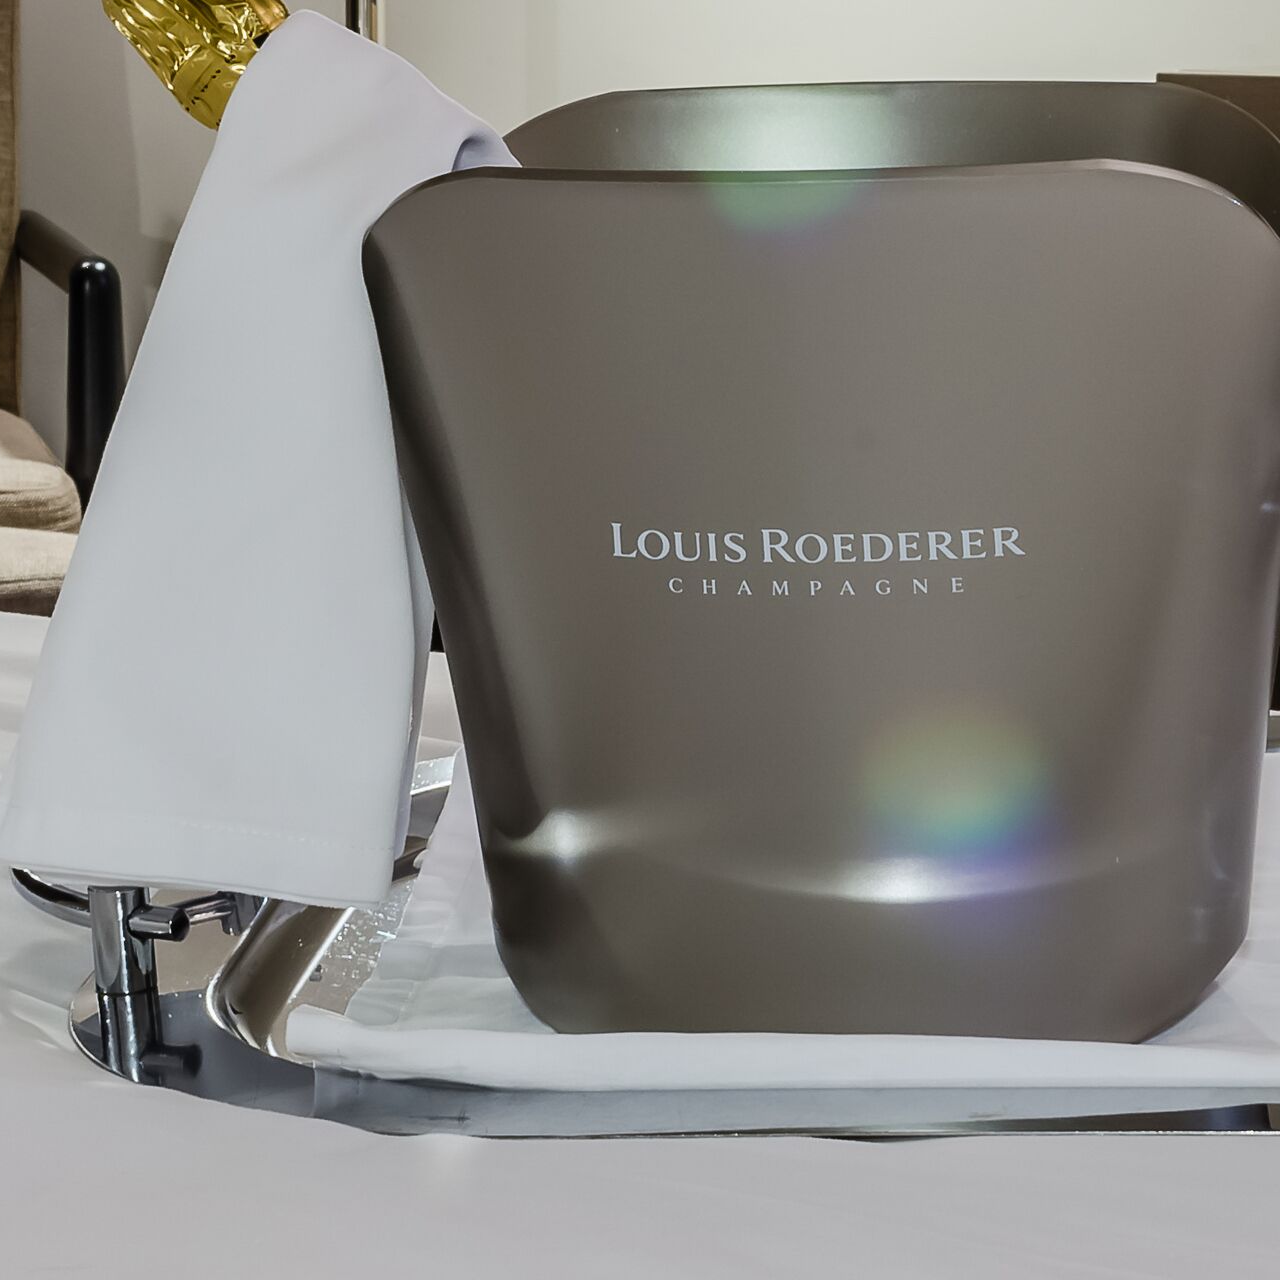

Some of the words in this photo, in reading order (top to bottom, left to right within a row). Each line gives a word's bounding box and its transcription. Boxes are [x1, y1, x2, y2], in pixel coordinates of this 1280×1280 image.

[610, 521, 748, 564] LOUIS
[761, 526, 1027, 565] ROEDERER
[667, 576, 965, 597] CHAMPAGNE
